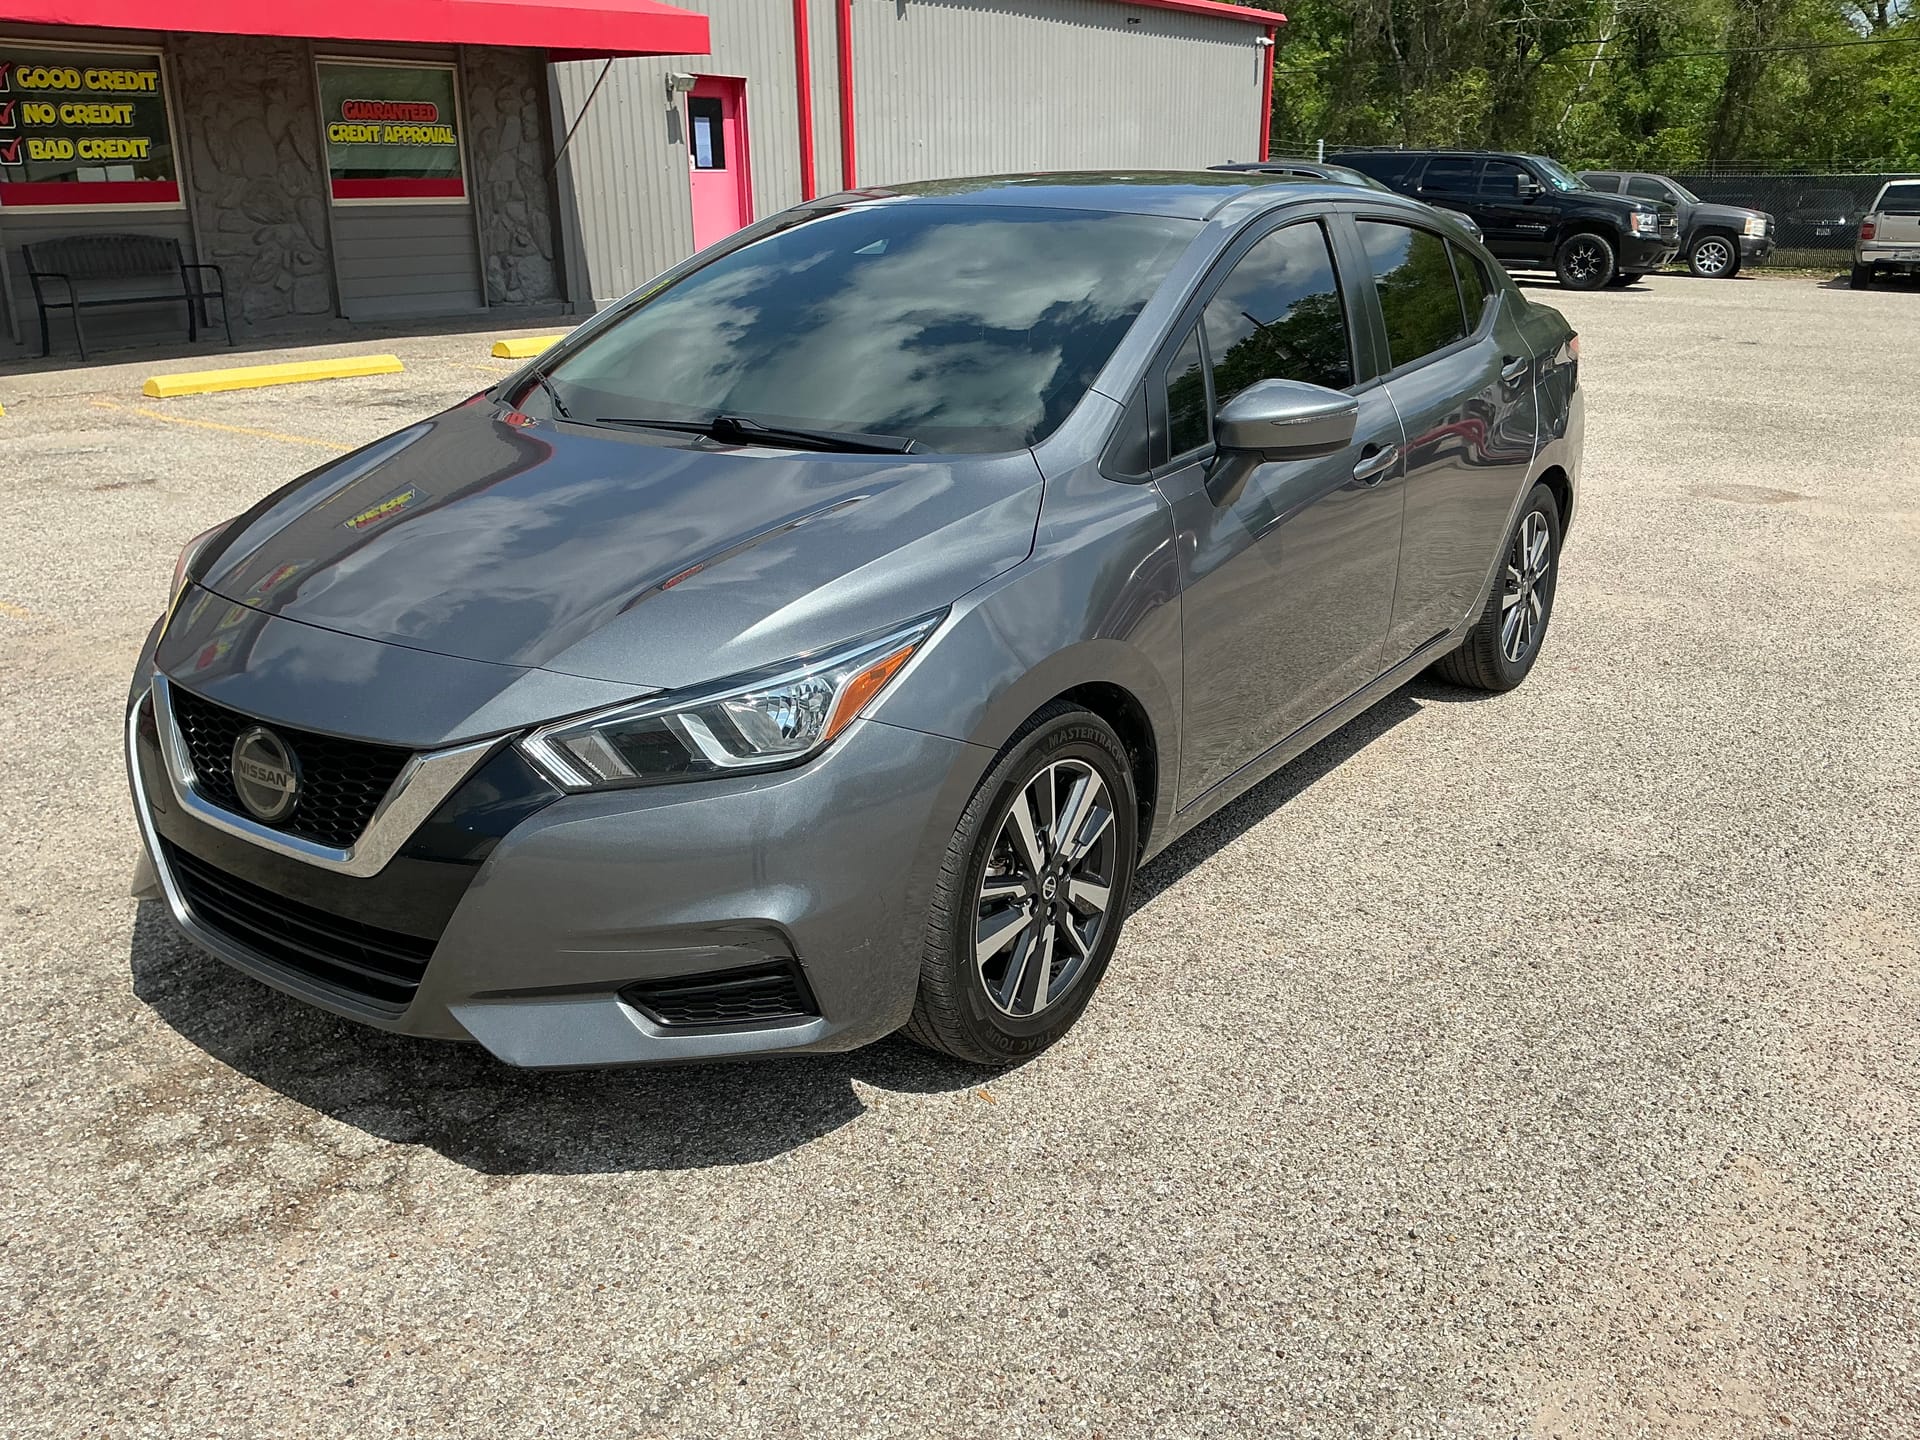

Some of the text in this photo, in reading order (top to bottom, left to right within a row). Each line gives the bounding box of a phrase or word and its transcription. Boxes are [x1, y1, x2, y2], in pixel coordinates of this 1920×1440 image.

[16, 66, 158, 92] GOOD CREDIT
[22, 102, 133, 125] NO CREDIT
[342, 100, 438, 122] GUARANTEED
[328, 123, 455, 145] CREDIT APPROVAL
[27, 138, 150, 161] BAD CREDIT
[1048, 726, 1125, 766] MASTERTRACK
[240, 760, 288, 788] NISSAN
